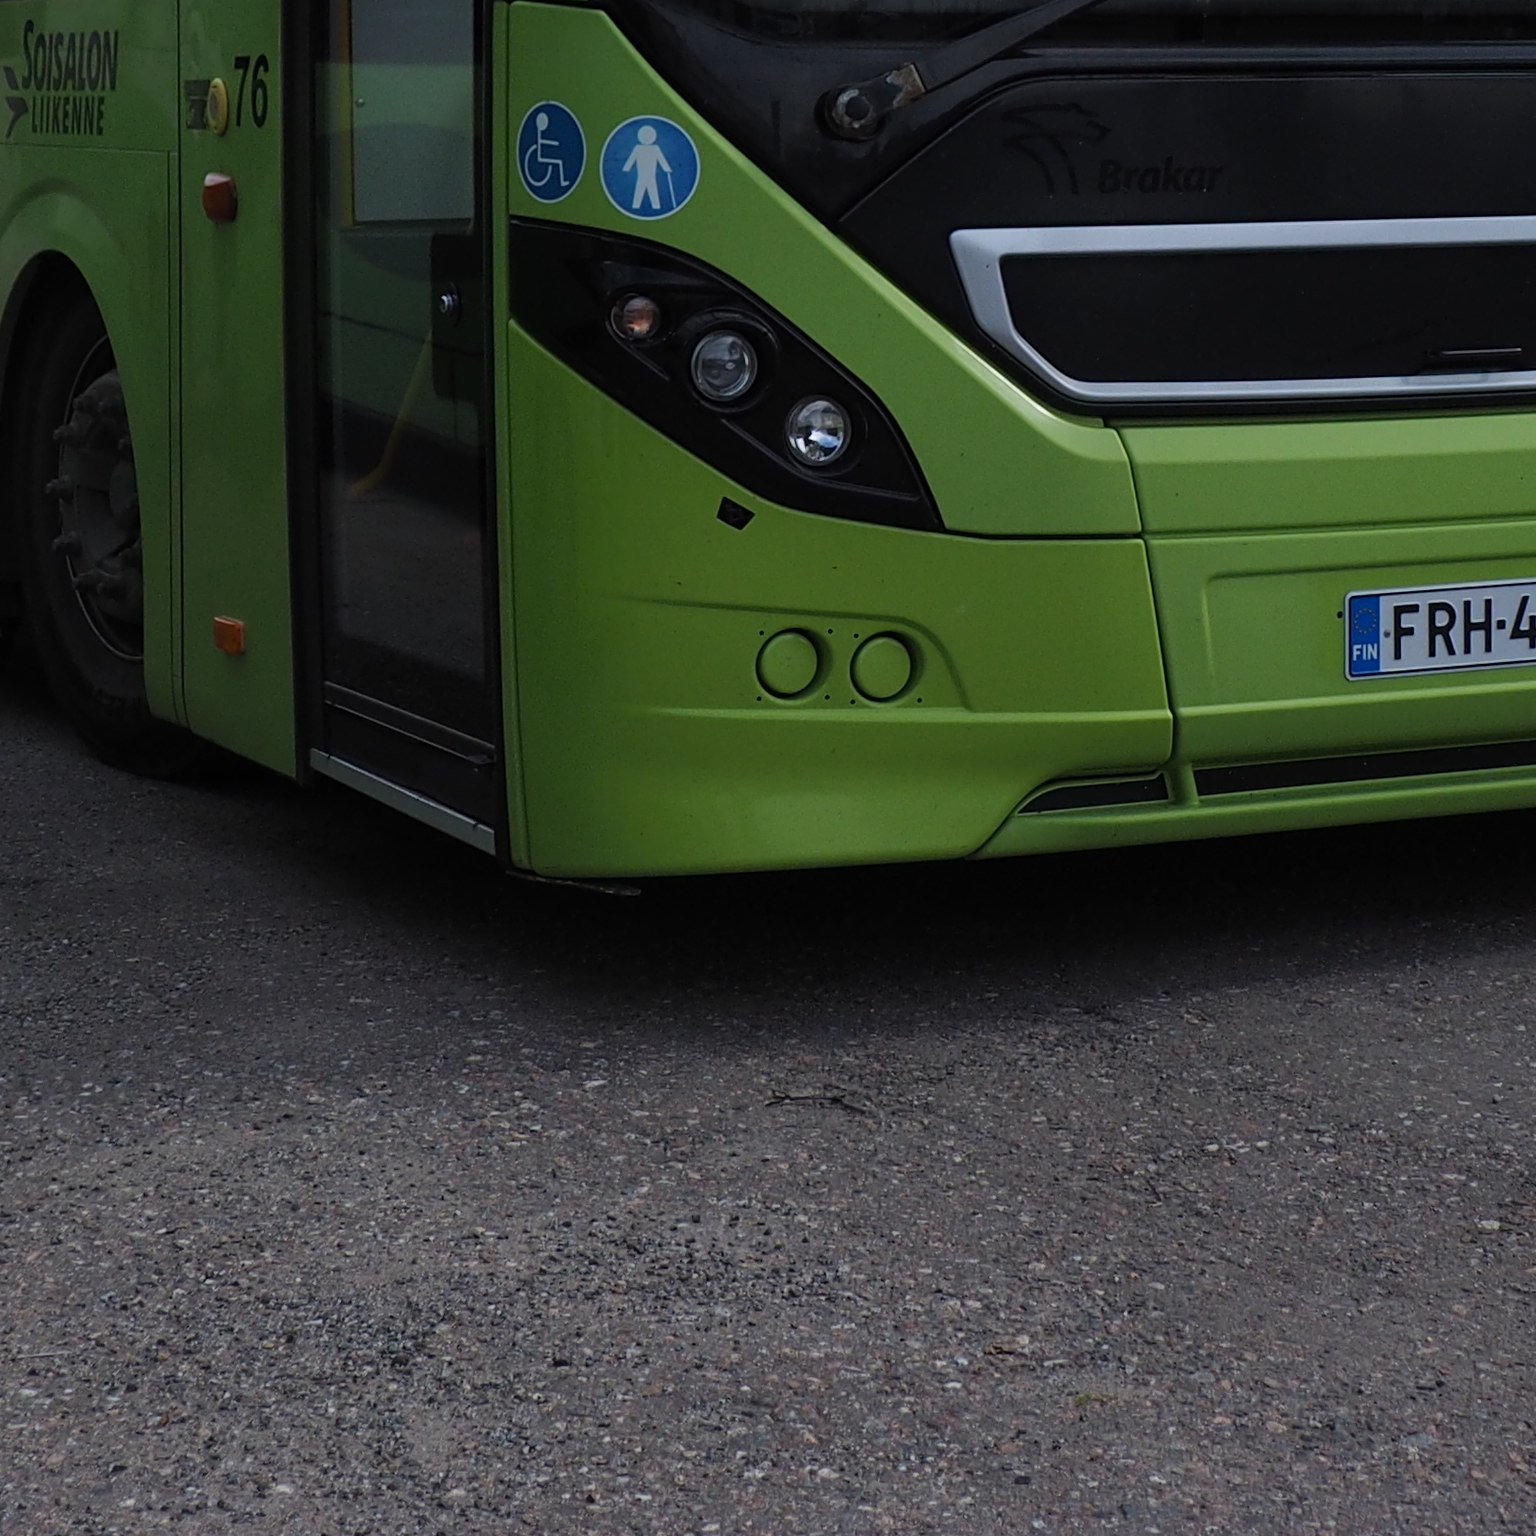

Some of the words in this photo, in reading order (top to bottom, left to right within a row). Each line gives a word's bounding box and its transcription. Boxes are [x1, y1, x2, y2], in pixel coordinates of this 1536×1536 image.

[21, 19, 119, 93] SOISALON
[233, 53, 270, 128] 76
[31, 95, 105, 136] LIIKENNE
[1097, 156, 1224, 195] Brakar
[1352, 643, 1378, 662] FIN
